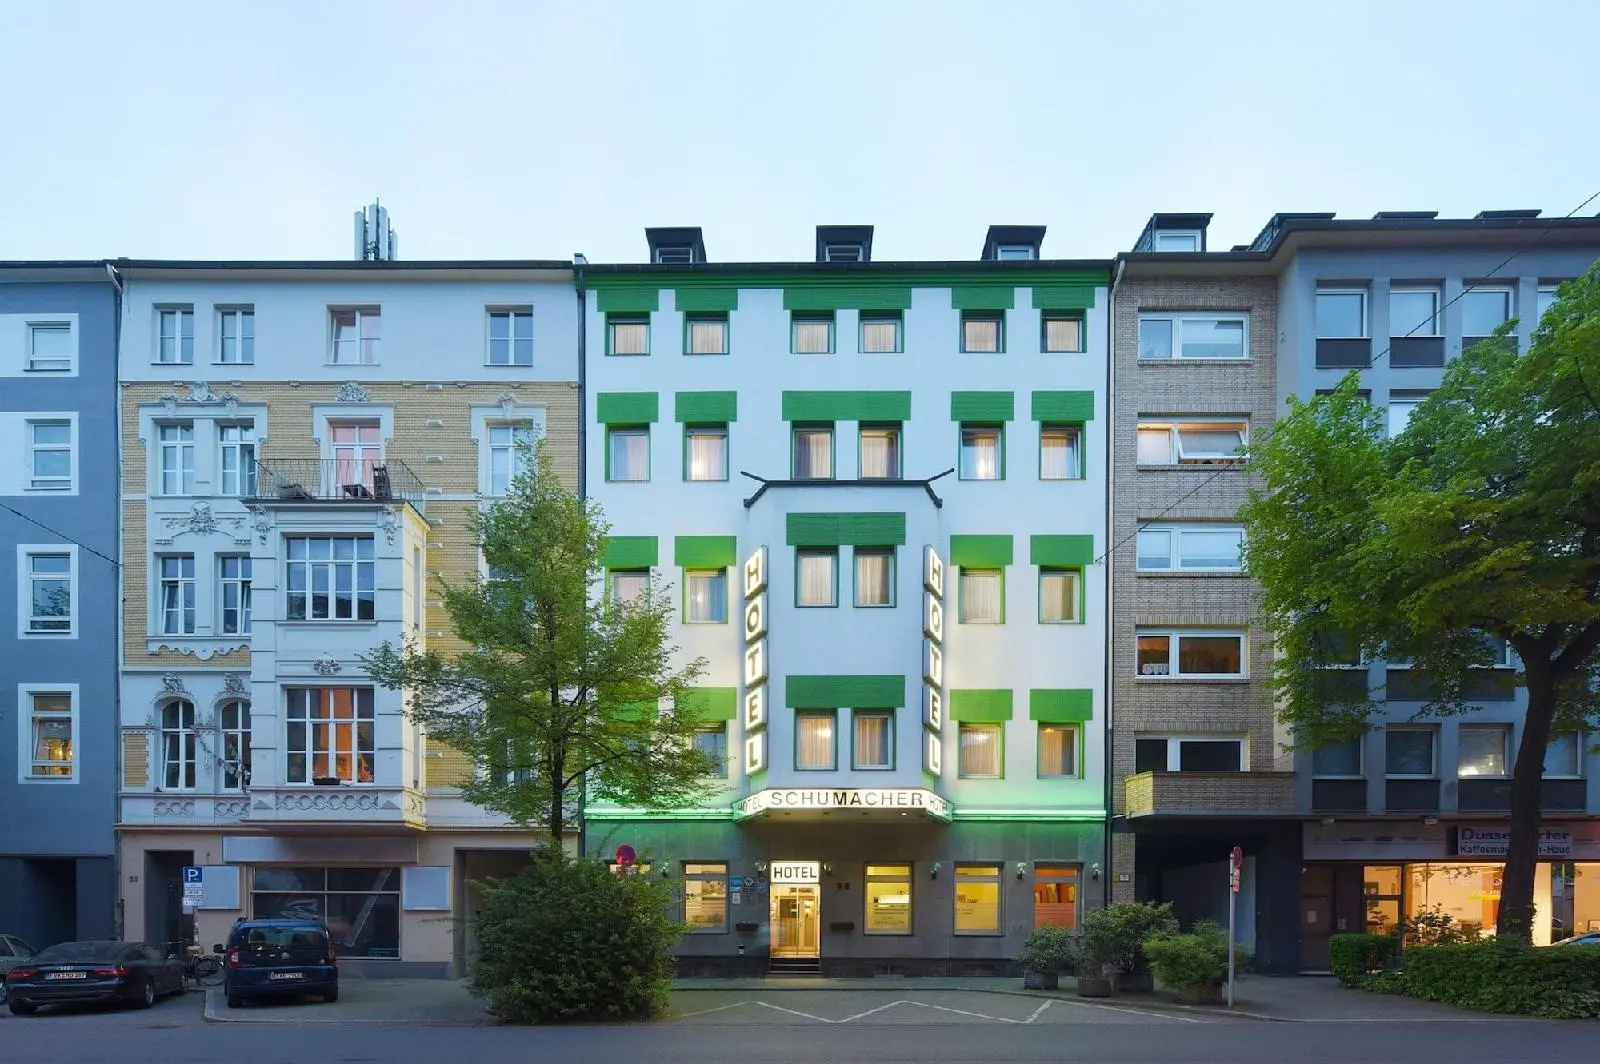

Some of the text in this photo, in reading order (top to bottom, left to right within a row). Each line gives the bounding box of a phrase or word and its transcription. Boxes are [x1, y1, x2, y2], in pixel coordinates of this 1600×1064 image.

[746, 555, 761, 769] HOTEL
[931, 553, 942, 769] HOTEL
[738, 791, 923, 811] HOTEL SCHUMACHER
[187, 868, 199, 882] P
[773, 866, 817, 879] HOTEL
